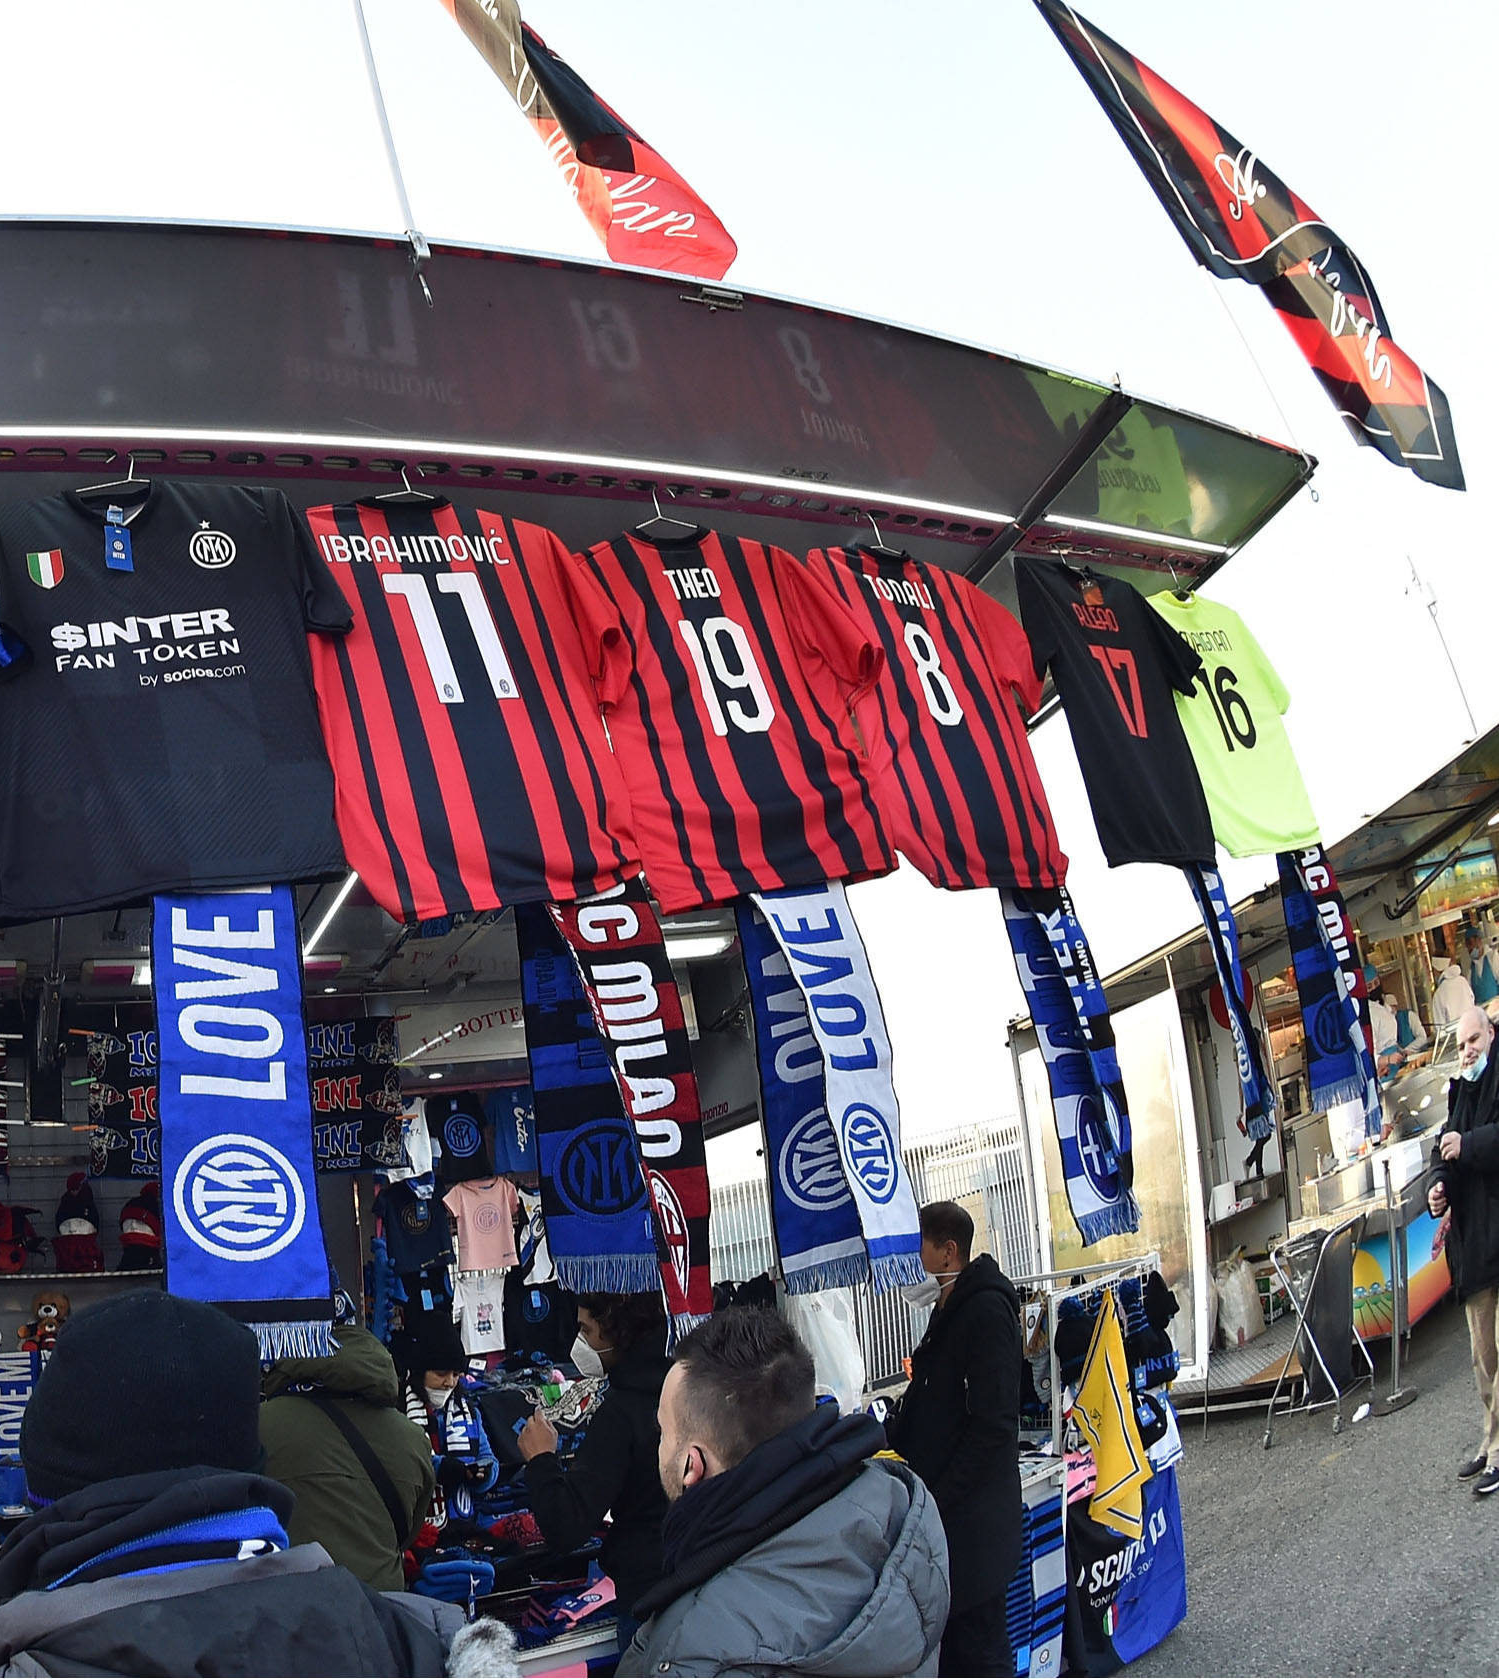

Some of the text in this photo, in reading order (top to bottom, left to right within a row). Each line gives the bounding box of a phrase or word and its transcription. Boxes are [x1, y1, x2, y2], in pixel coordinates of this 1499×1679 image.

[320, 529, 510, 565] IBRAHIMOVIĆ
[662, 568, 722, 600] THEO
[863, 574, 934, 611] TONALI
[55, 637, 241, 672] FAN TOKEN
[382, 572, 520, 703] 11
[139, 663, 247, 687] by socios.com
[678, 617, 776, 737] 19
[903, 621, 964, 727] 8
[1088, 644, 1149, 739] 17
[1198, 666, 1258, 752] 16
[1062, 901, 1077, 928] SAN
[770, 907, 879, 1072] LOVE
[1074, 939, 1097, 991] MILANO
[171, 906, 288, 1101] LOVE
[455, 1006, 524, 1039] BOTTE
[590, 960, 682, 1159] MILAN
